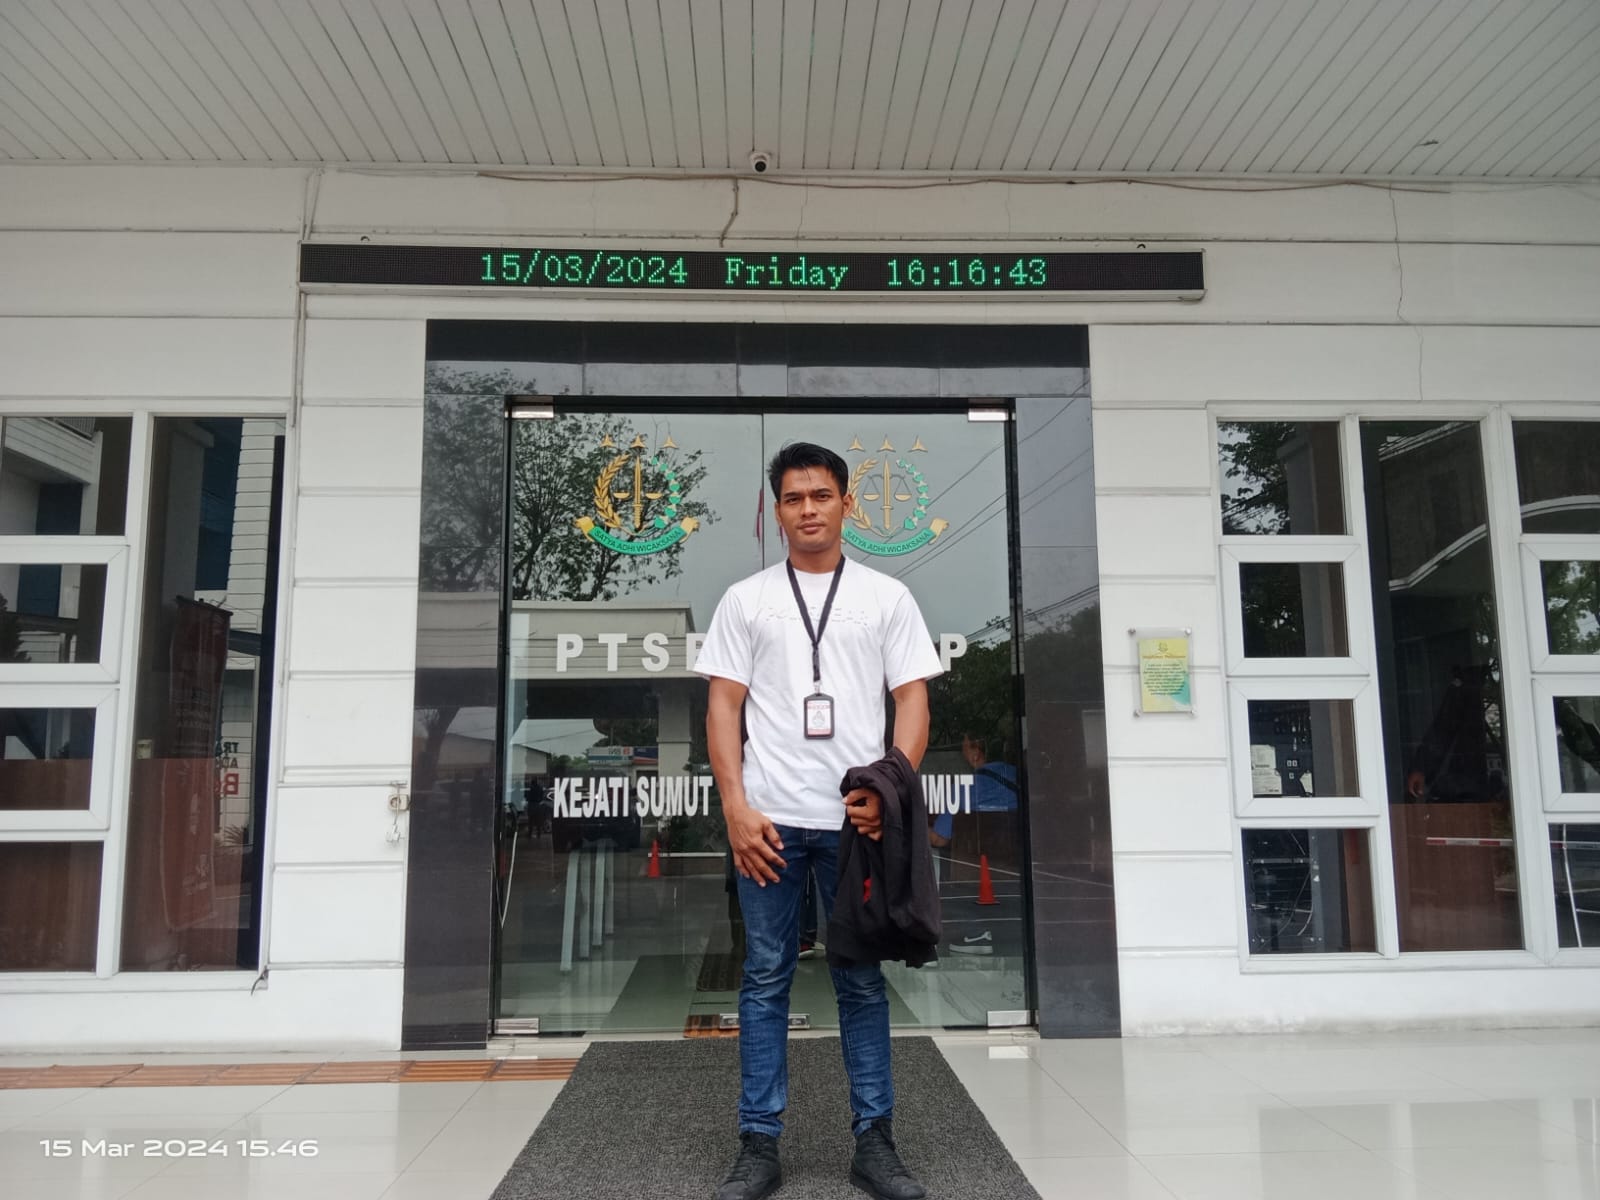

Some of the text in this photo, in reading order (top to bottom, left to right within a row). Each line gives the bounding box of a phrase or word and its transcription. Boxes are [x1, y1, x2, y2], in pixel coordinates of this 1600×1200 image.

[481, 250, 1046, 290] 15/03/2024 Friday 16:16:43
[594, 529, 681, 552] SATYA ADHI WICAKSANA
[845, 530, 931, 553] SATYA ADHI WICAKSANA
[553, 775, 713, 818] KEJATI SUMUT
[921, 774, 974, 815] MUT
